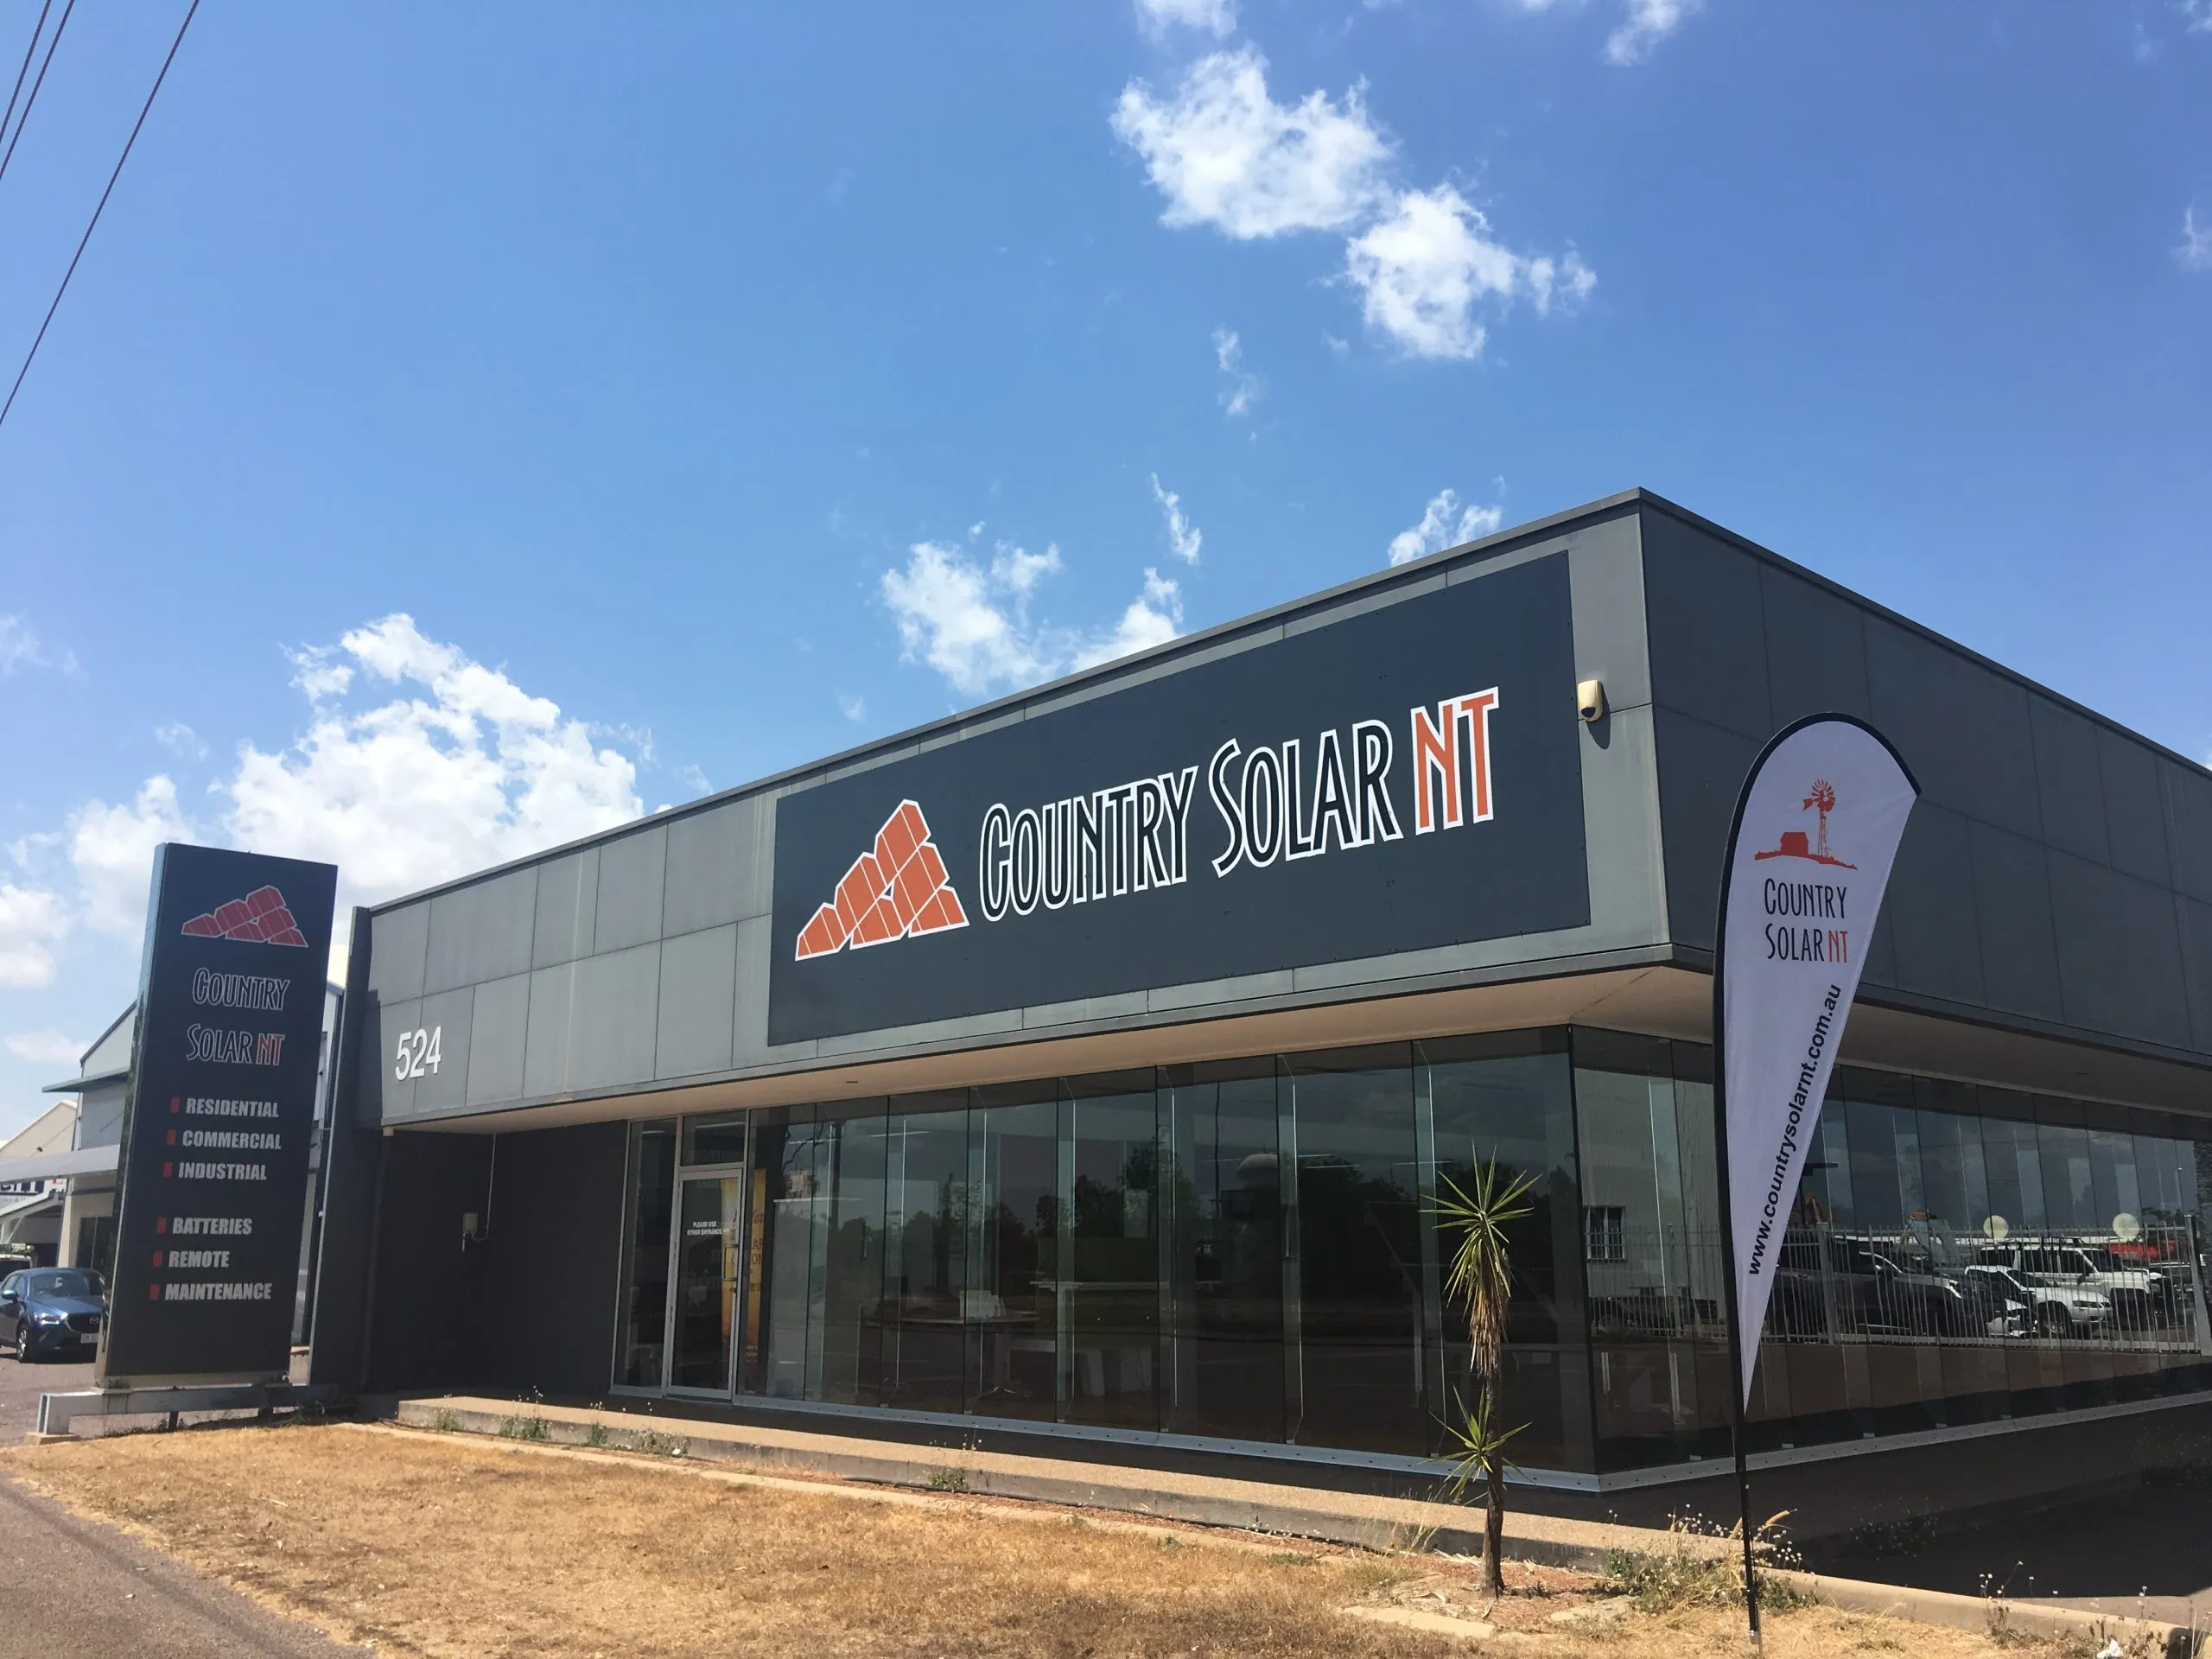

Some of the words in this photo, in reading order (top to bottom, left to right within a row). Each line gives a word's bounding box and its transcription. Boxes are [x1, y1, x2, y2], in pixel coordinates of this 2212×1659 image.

[979, 765, 1198, 922] COUNTRY
[1208, 719, 1404, 878] SOLAR
[1410, 686, 1499, 836] NT
[1764, 878, 1847, 918] COUNTRY
[1765, 922, 1825, 962] SOLAR
[1827, 930, 1848, 963] NT
[193, 967, 290, 1010] COUNTRY
[186, 1023, 252, 1064] SOLAR
[256, 1033, 285, 1065] NT
[395, 1026, 442, 1081] 524
[186, 1097, 279, 1117] RESIDENTIAL
[182, 1129, 282, 1150] COMMERCIAL
[1748, 983, 1841, 1276] www.countrysolarnt.com.au
[178, 1162, 267, 1180] INDUSTRIAL
[173, 1217, 252, 1235] BATTERIES
[168, 1250, 230, 1268] REMOTE
[165, 1283, 272, 1300] MAINTENANCE
